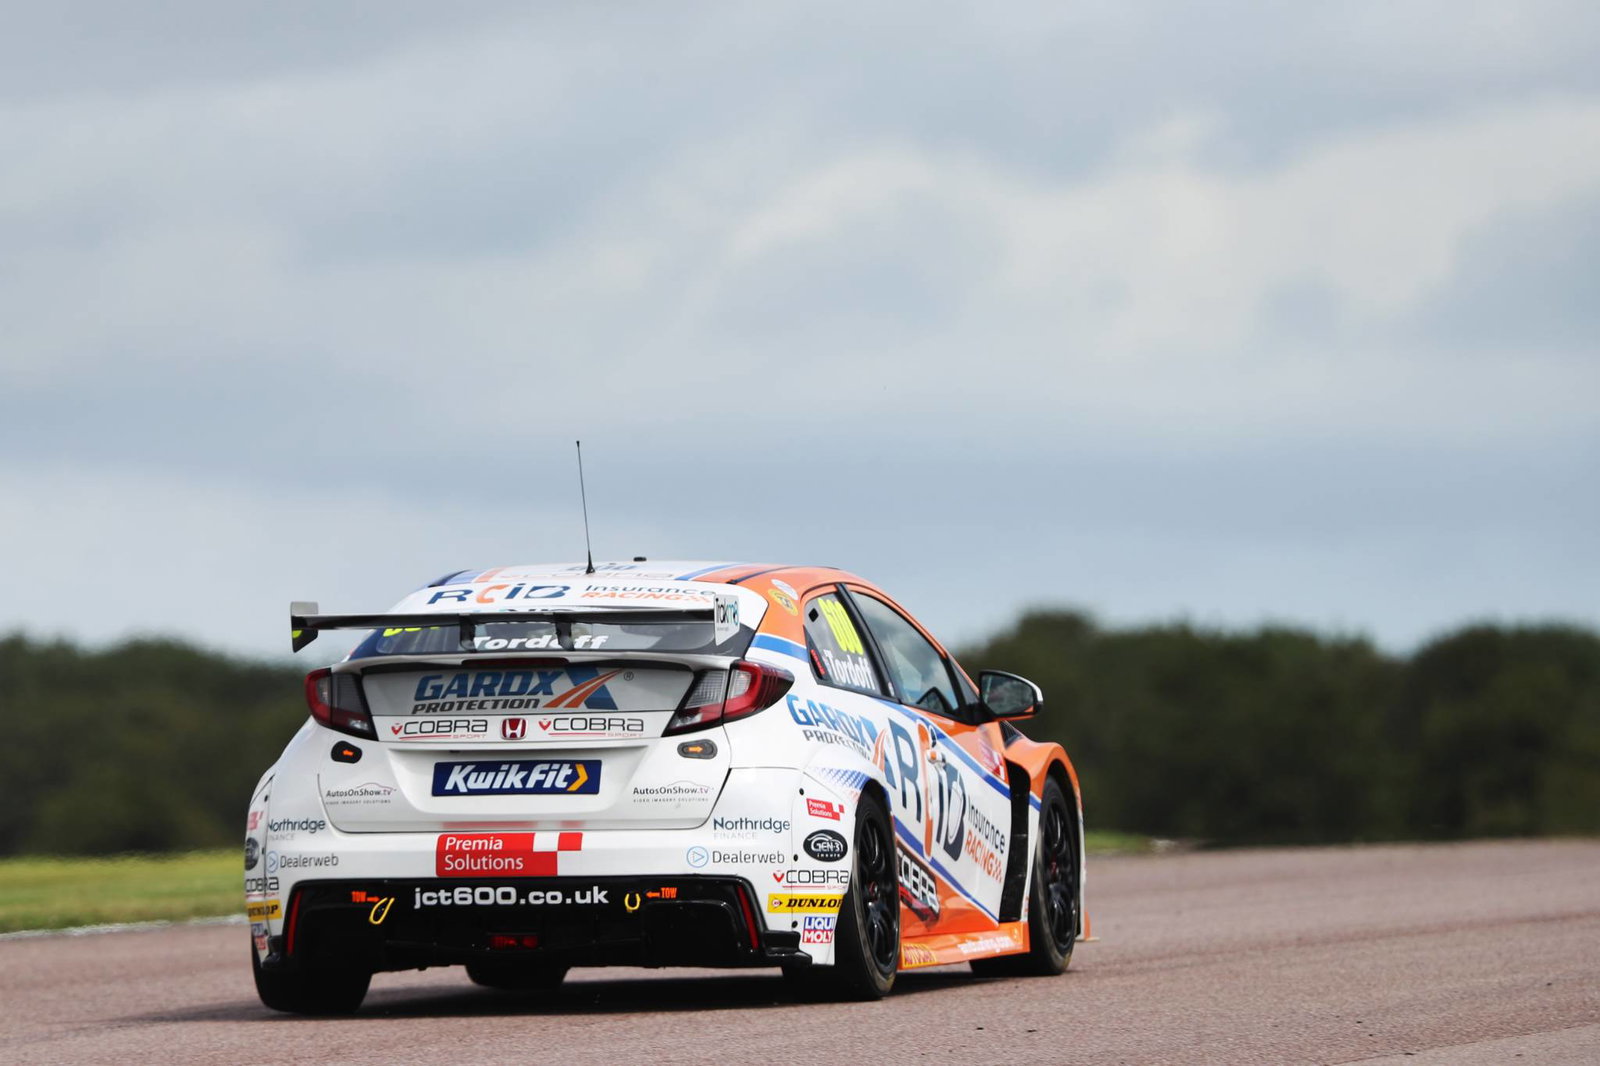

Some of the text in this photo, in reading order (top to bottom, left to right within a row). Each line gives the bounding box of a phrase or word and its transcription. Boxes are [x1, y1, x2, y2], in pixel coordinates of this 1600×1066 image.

[581, 592, 683, 601] RACING
[585, 584, 716, 596] Insurance
[823, 649, 876, 690] Tordoff
[411, 698, 540, 715] PROTECTION
[633, 786, 709, 795] AutosOnShow.tv
[713, 817, 791, 834] Northridge
[967, 795, 1006, 855] Insurance
[445, 836, 504, 850] Premia
[280, 853, 339, 868] Dealerweb
[444, 854, 524, 871] Solutions
[712, 850, 785, 864] Dealerweb
[413, 886, 609, 909] jct600.co.uk
[661, 887, 677, 899] TOW
[804, 930, 834, 943] MOLY
